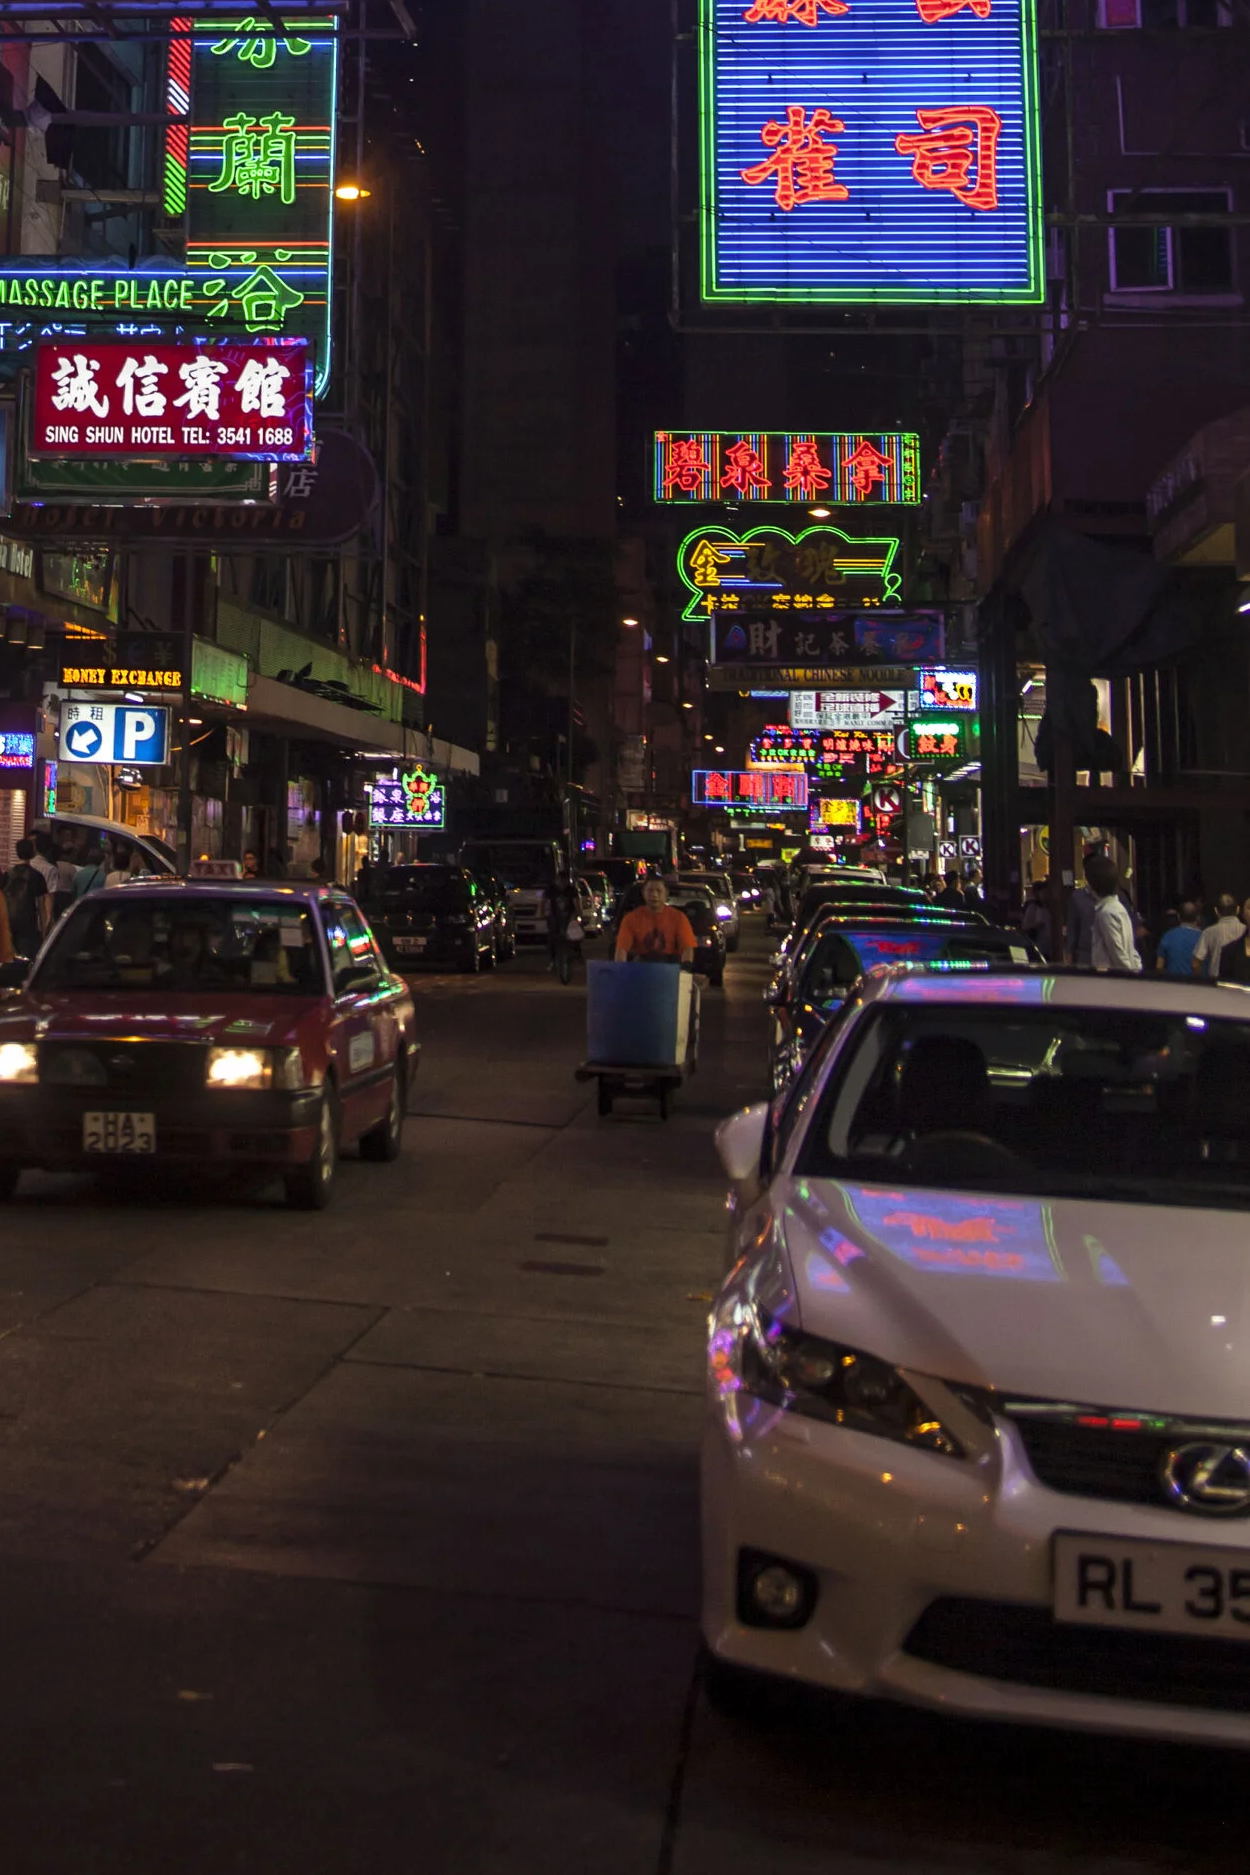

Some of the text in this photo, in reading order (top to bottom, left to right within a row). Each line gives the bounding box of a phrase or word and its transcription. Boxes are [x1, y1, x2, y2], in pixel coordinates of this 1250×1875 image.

[114, 279, 196, 310] PLACE
[49, 356, 291, 421] 誠信賓館
[45, 425, 293, 446] SING SHUN HOTEL TEL: 3541 1688
[663, 440, 893, 494] 碧泉桑拿
[62, 668, 182, 687] MONEY EXCHANGE
[805, 667, 854, 682] CHINESE
[68, 706, 155, 760] 時租 P
[104, 1113, 135, 1131] HA
[88, 1133, 153, 1154] 2023
[1077, 1553, 1162, 1614] RL
